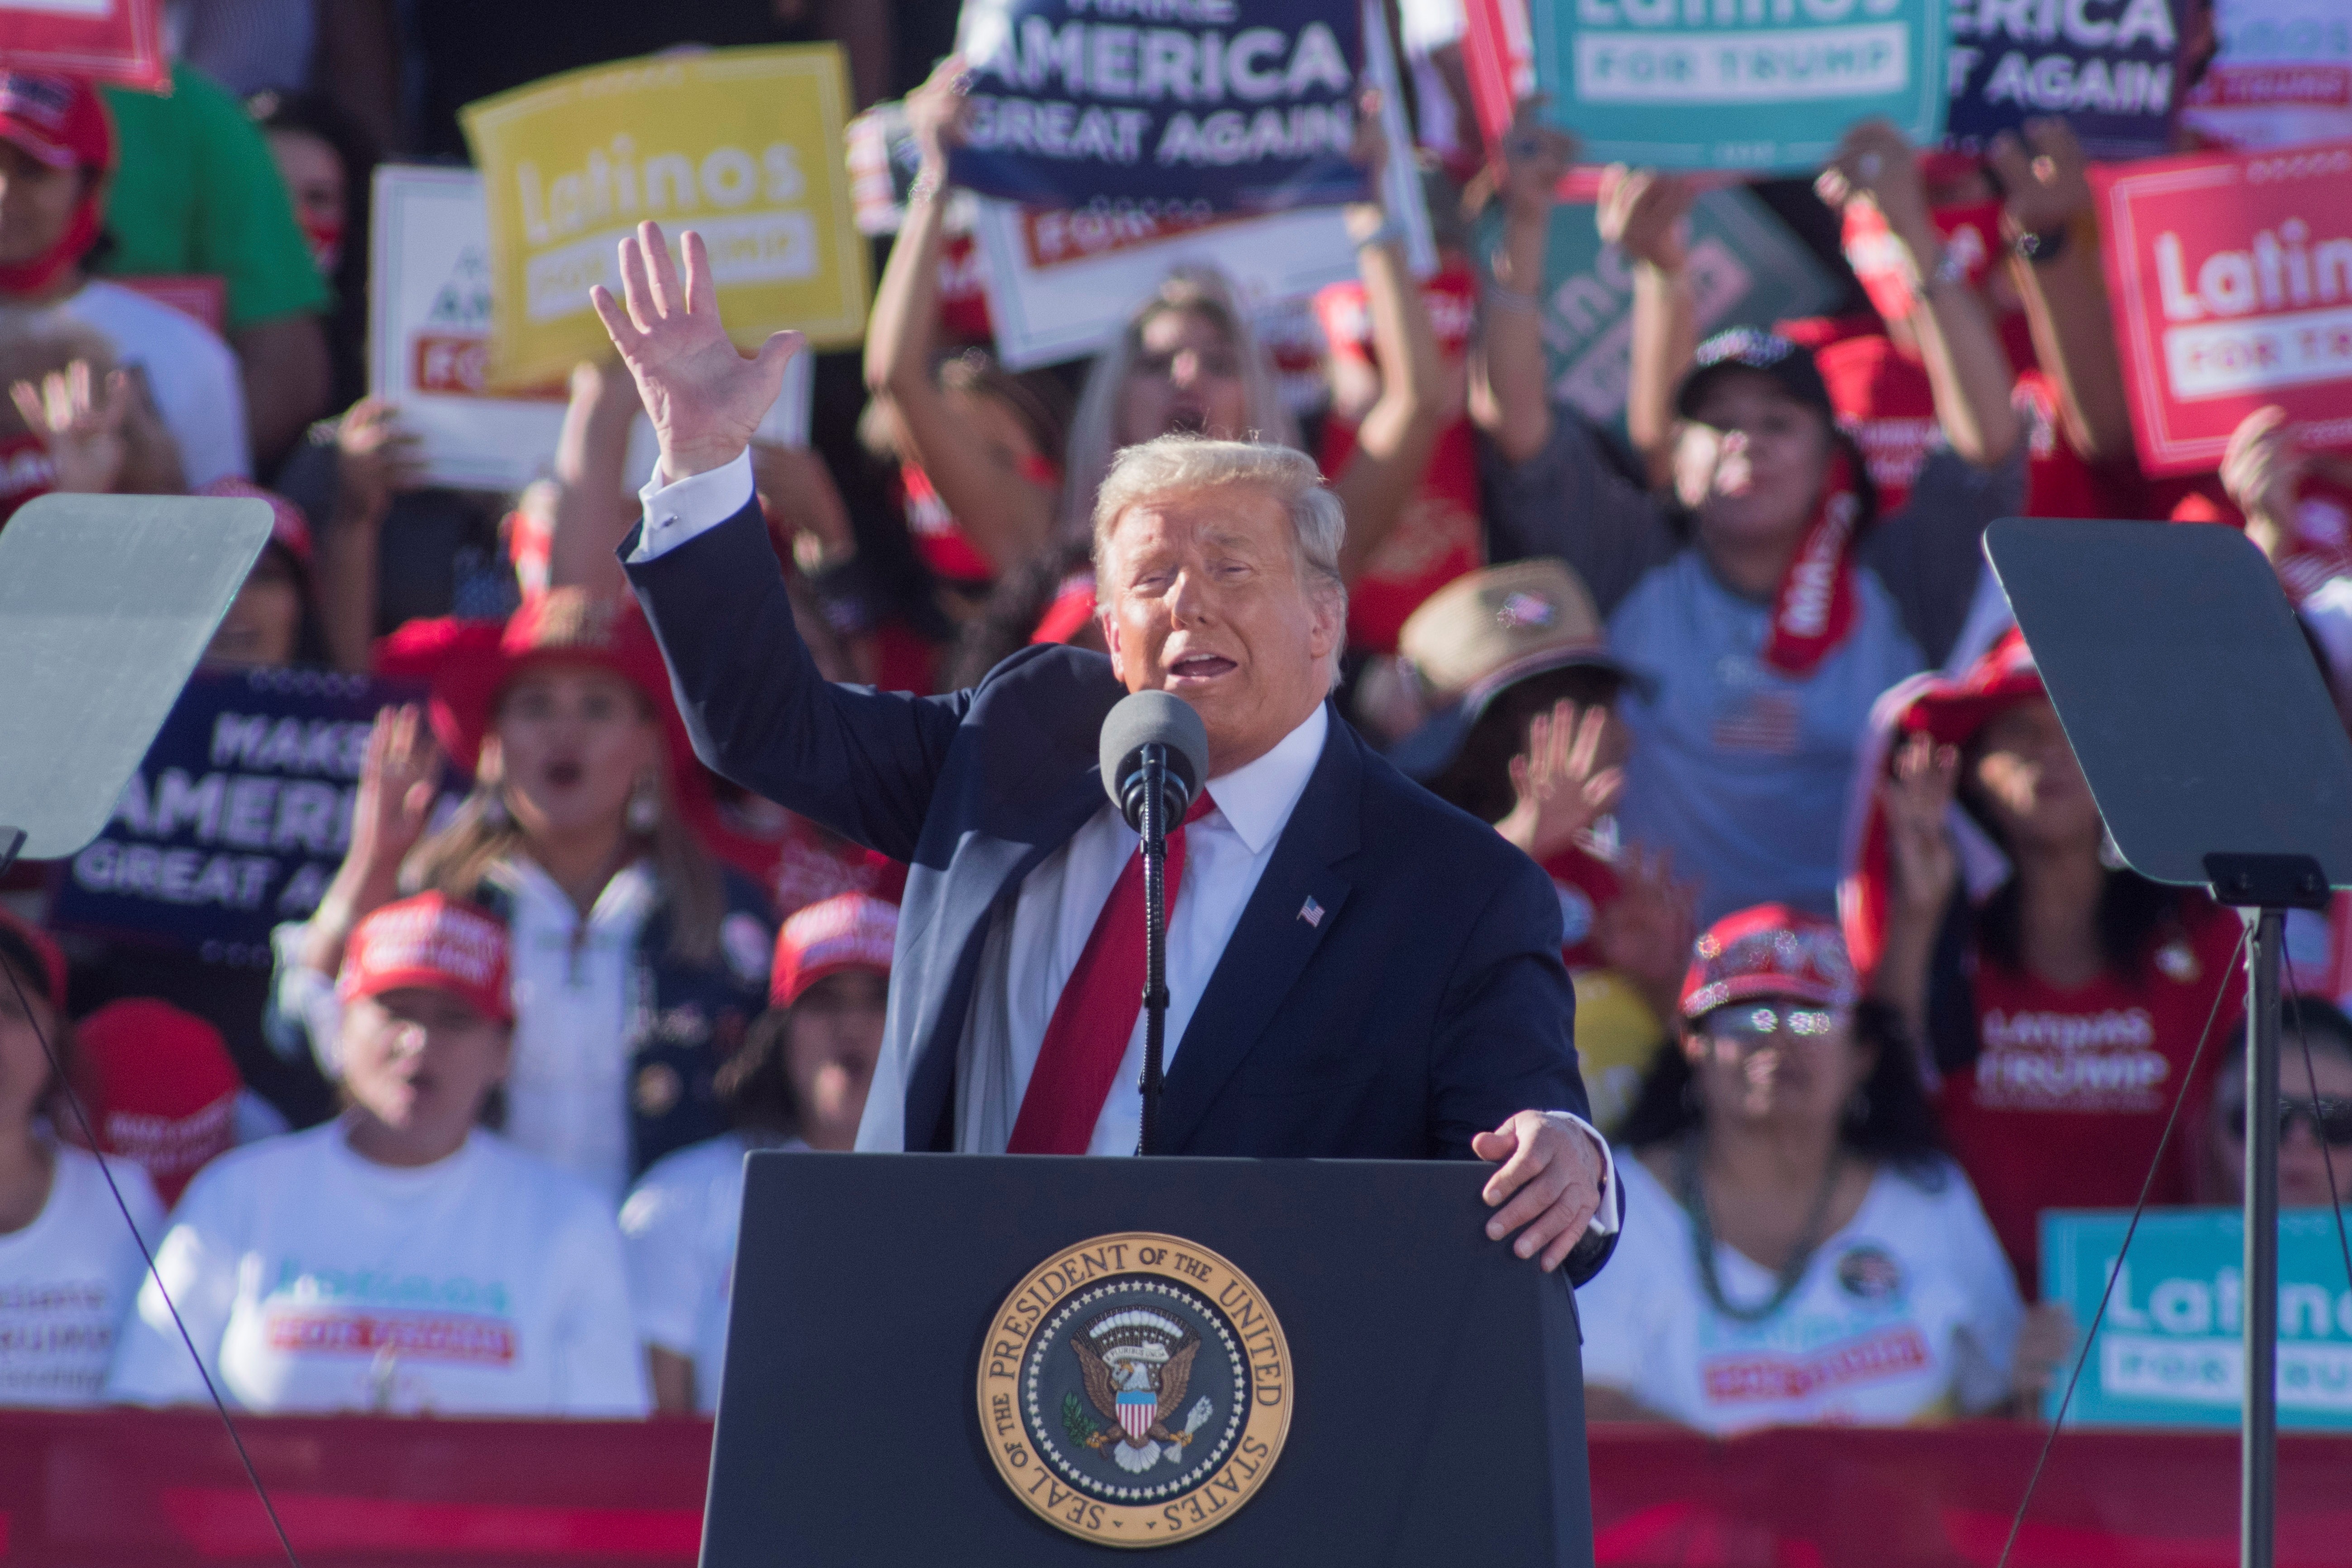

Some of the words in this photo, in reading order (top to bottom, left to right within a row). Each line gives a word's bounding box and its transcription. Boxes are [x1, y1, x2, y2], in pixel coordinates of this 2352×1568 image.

[1594, 48, 1697, 82] FOR
[1715, 39, 1893, 82] TRUMP
[1985, 51, 2172, 113] AGAIN
[969, 96, 1152, 164] GREAT
[1155, 99, 1354, 166] AGAIN
[517, 134, 807, 244] Latinos
[2155, 216, 2352, 320] Latin
[75, 840, 272, 908] GREAT
[1138, 1247, 1168, 1266] OF
[1174, 1251, 1213, 1283] THE
[989, 1243, 1128, 1380] PRESIDENT
[2106, 1256, 2352, 1338] Latn
[1219, 1279, 1282, 1406] UNITED
[2118, 1355, 2229, 1386] FOR
[993, 1393, 1015, 1436] THE
[1003, 1441, 1029, 1468] OF
[1163, 1435, 1268, 1531] STATES
[1028, 1467, 1105, 1530] SEAL
